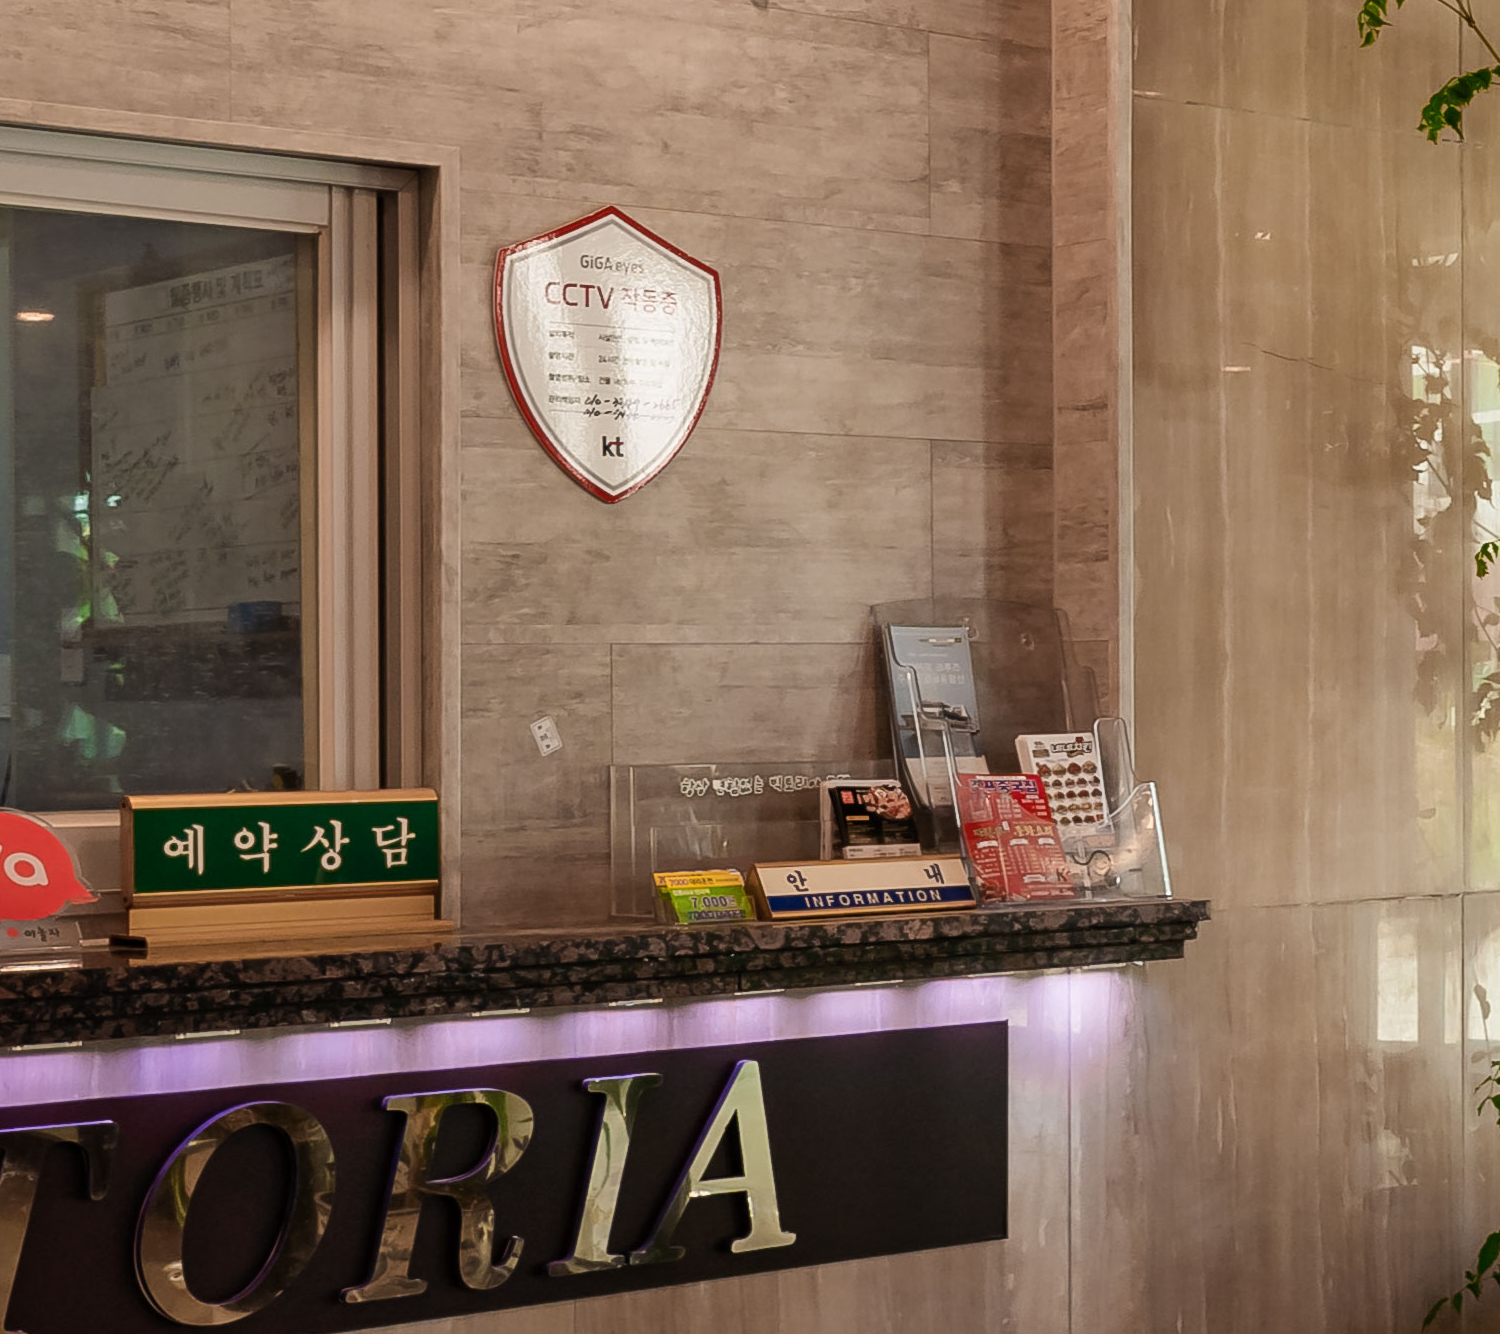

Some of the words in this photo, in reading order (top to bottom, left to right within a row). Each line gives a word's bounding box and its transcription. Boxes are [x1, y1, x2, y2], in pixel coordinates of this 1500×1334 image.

[544, 280, 614, 310] CCTV
[602, 435, 624, 458] kt
[803, 888, 943, 909] INFORMATION
